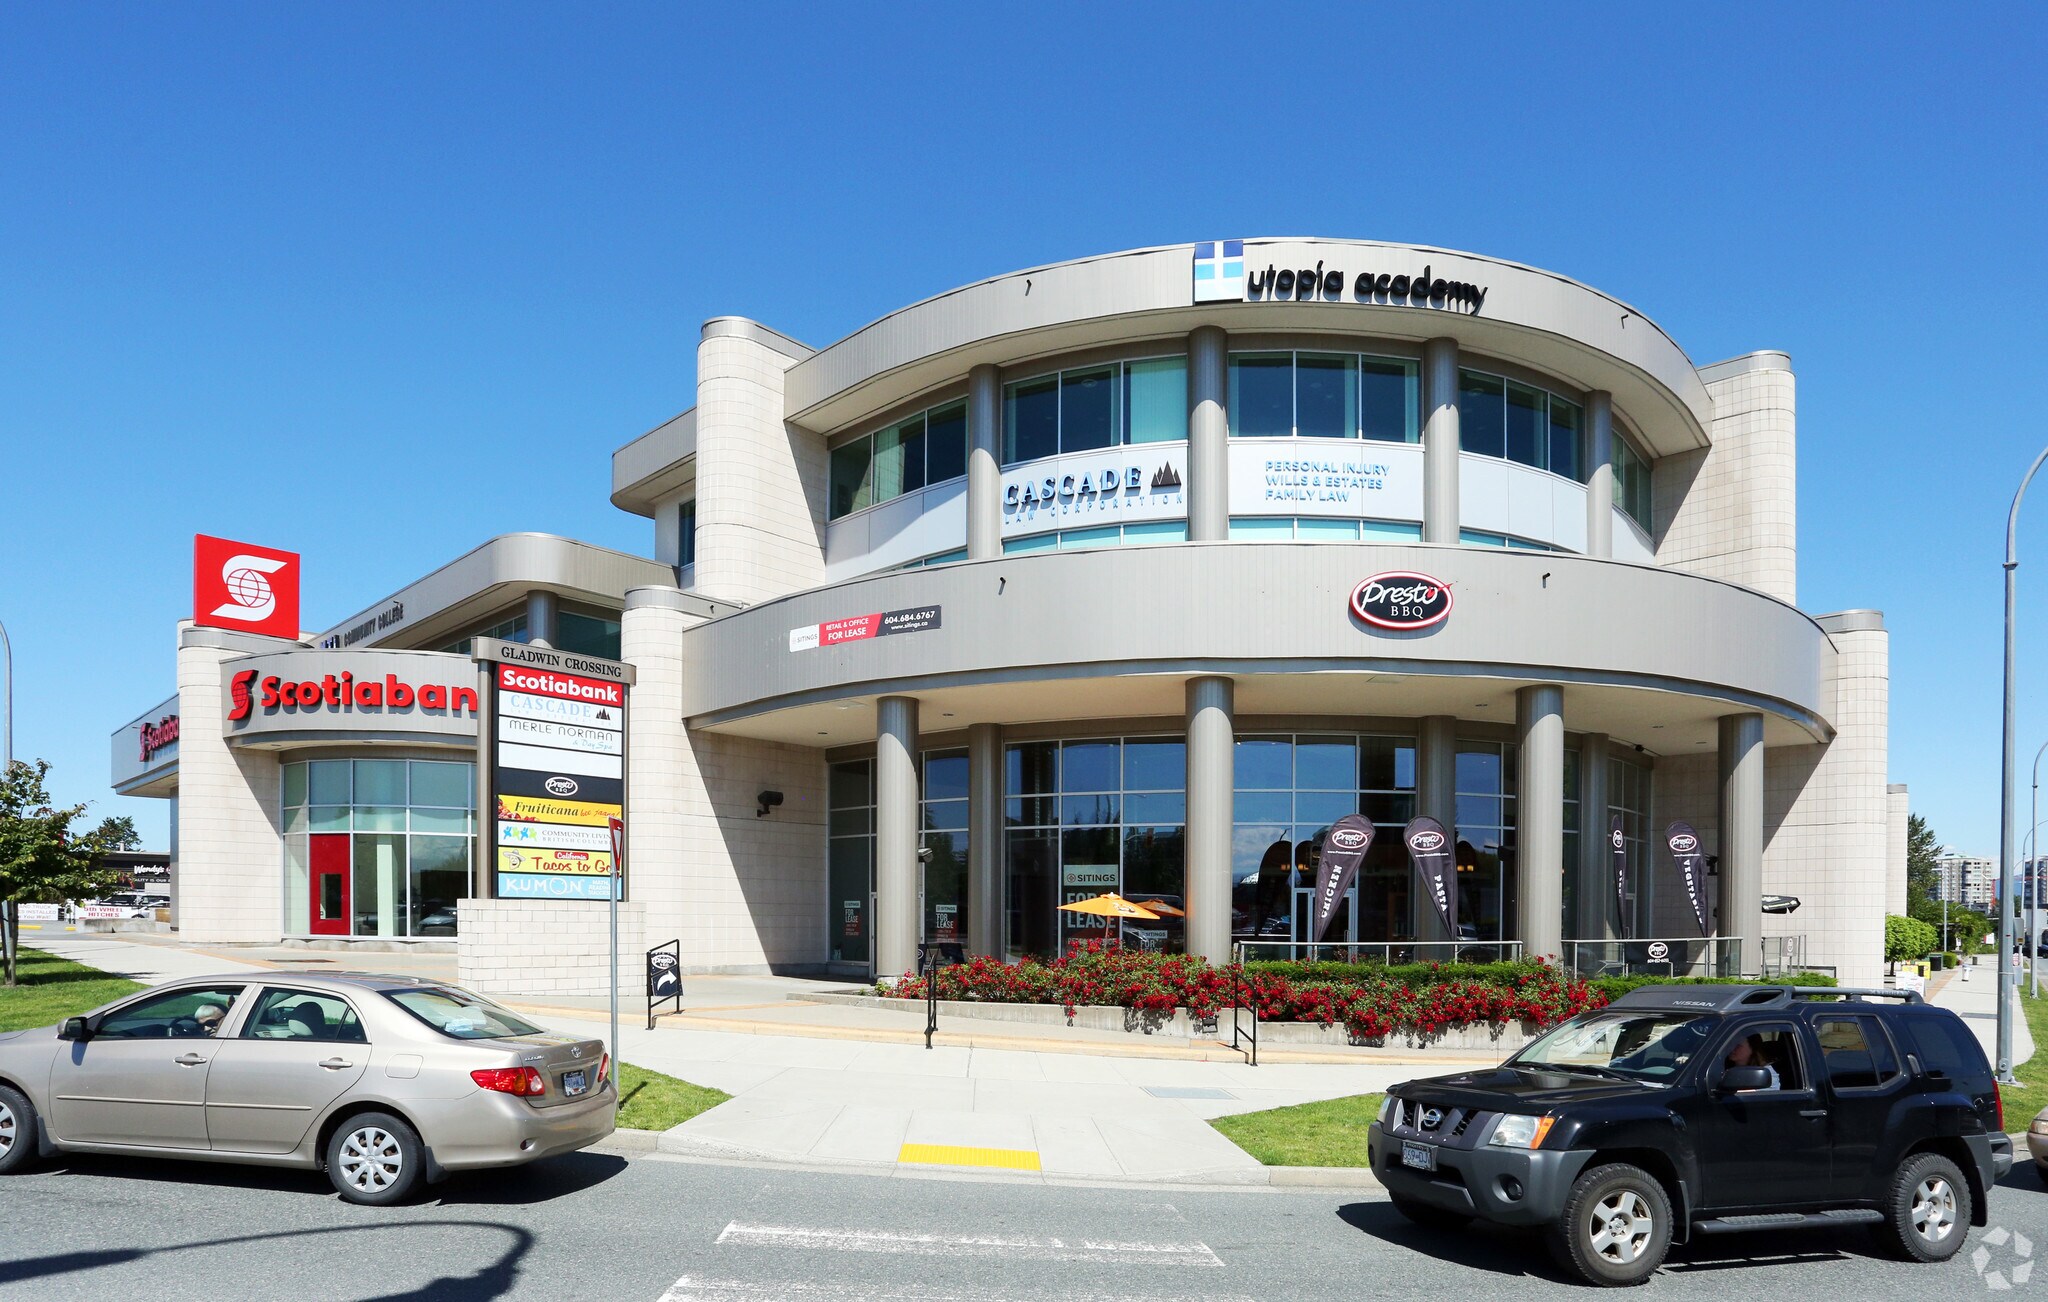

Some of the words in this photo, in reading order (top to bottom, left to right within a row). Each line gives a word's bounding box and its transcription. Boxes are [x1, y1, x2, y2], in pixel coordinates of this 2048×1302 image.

[1354, 265, 1488, 316] academy
[1265, 460, 1338, 473] PERSONAL
[1343, 462, 1390, 476] INJURY
[1003, 465, 1142, 508] CASCADE
[1265, 475, 1309, 486] WILLS
[1312, 476, 1321, 487] &
[1325, 476, 1383, 489] ESTATES
[1265, 489, 1315, 501] FAMILY
[1319, 490, 1350, 502] LAW
[1004, 510, 1036, 525] LAW
[1050, 494, 1183, 518] CORPORATION
[1360, 581, 1438, 612] Presto
[884, 610, 936, 625] 604.684.6767
[1391, 605, 1424, 619] BBQ
[343, 617, 377, 648] COMMUNITY
[378, 602, 404, 632] COLLEGE
[825, 621, 843, 631] RETAIL
[848, 617, 869, 627] OFFICE
[797, 633, 818, 643] SITINGS
[827, 631, 843, 641] FOR
[844, 627, 867, 638] LEASE
[501, 646, 561, 667] GLADWIN
[564, 657, 621, 678] CROSSING
[261, 671, 478, 713] Scotiaban
[503, 669, 618, 702] Scotiabank
[510, 694, 592, 718] CASCADE
[509, 719, 552, 735] MERLE
[558, 726, 613, 742] NORMAN
[548, 779, 574, 791] Presto
[514, 801, 579, 816] Fruiticana
[542, 829, 590, 839] COMMUNITY
[133, 865, 165, 875] Wendy's
[531, 857, 572, 872] Tacos
[577, 860, 591, 872] to
[1077, 874, 1116, 882] SITINGS
[503, 877, 585, 895] KUMON
[1321, 864, 1343, 918] CHICKEN
[1434, 874, 1448, 912] PASTA
[845, 908, 854, 916] FOR
[845, 915, 859, 923] LEASE
[936, 920, 954, 929] LEASE
[1140, 939, 1156, 948] FOR
